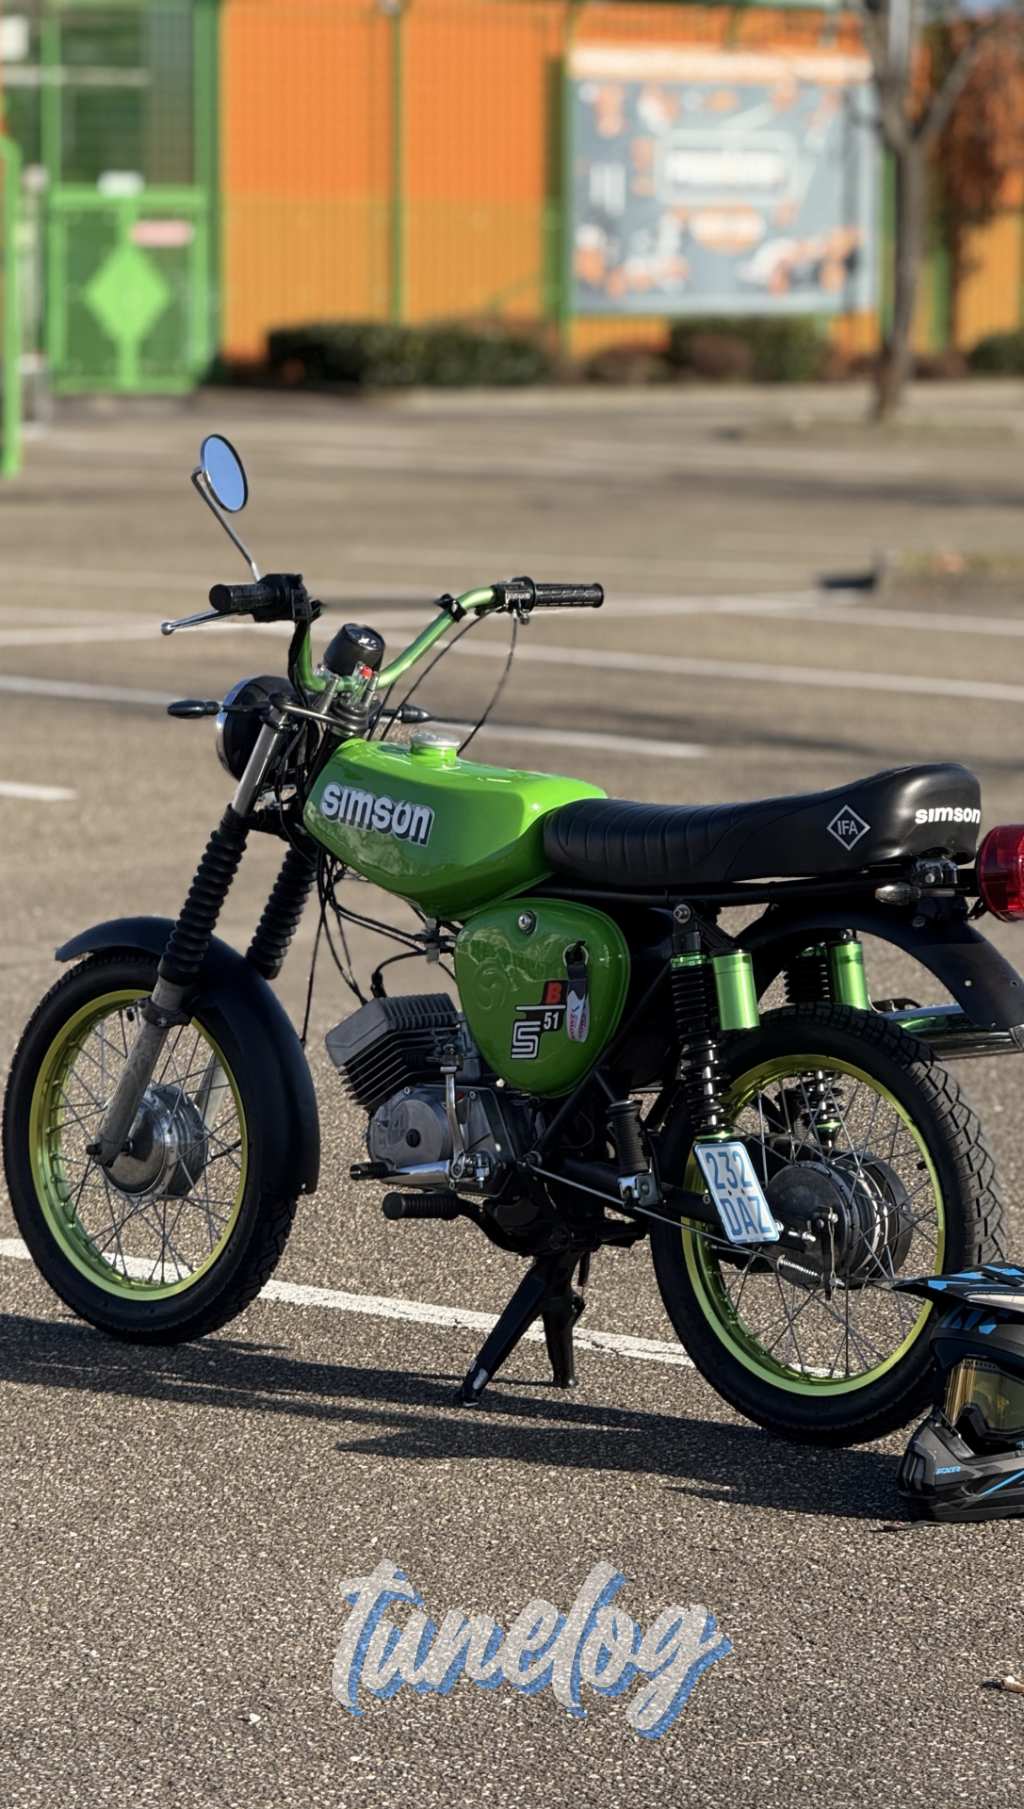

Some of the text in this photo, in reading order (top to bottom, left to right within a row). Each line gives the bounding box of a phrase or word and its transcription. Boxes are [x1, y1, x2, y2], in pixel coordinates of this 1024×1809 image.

[836, 819, 858, 836] IFA
[544, 981, 563, 1005] B
[705, 1151, 752, 1190] 232
[719, 1195, 772, 1236] DAZ
